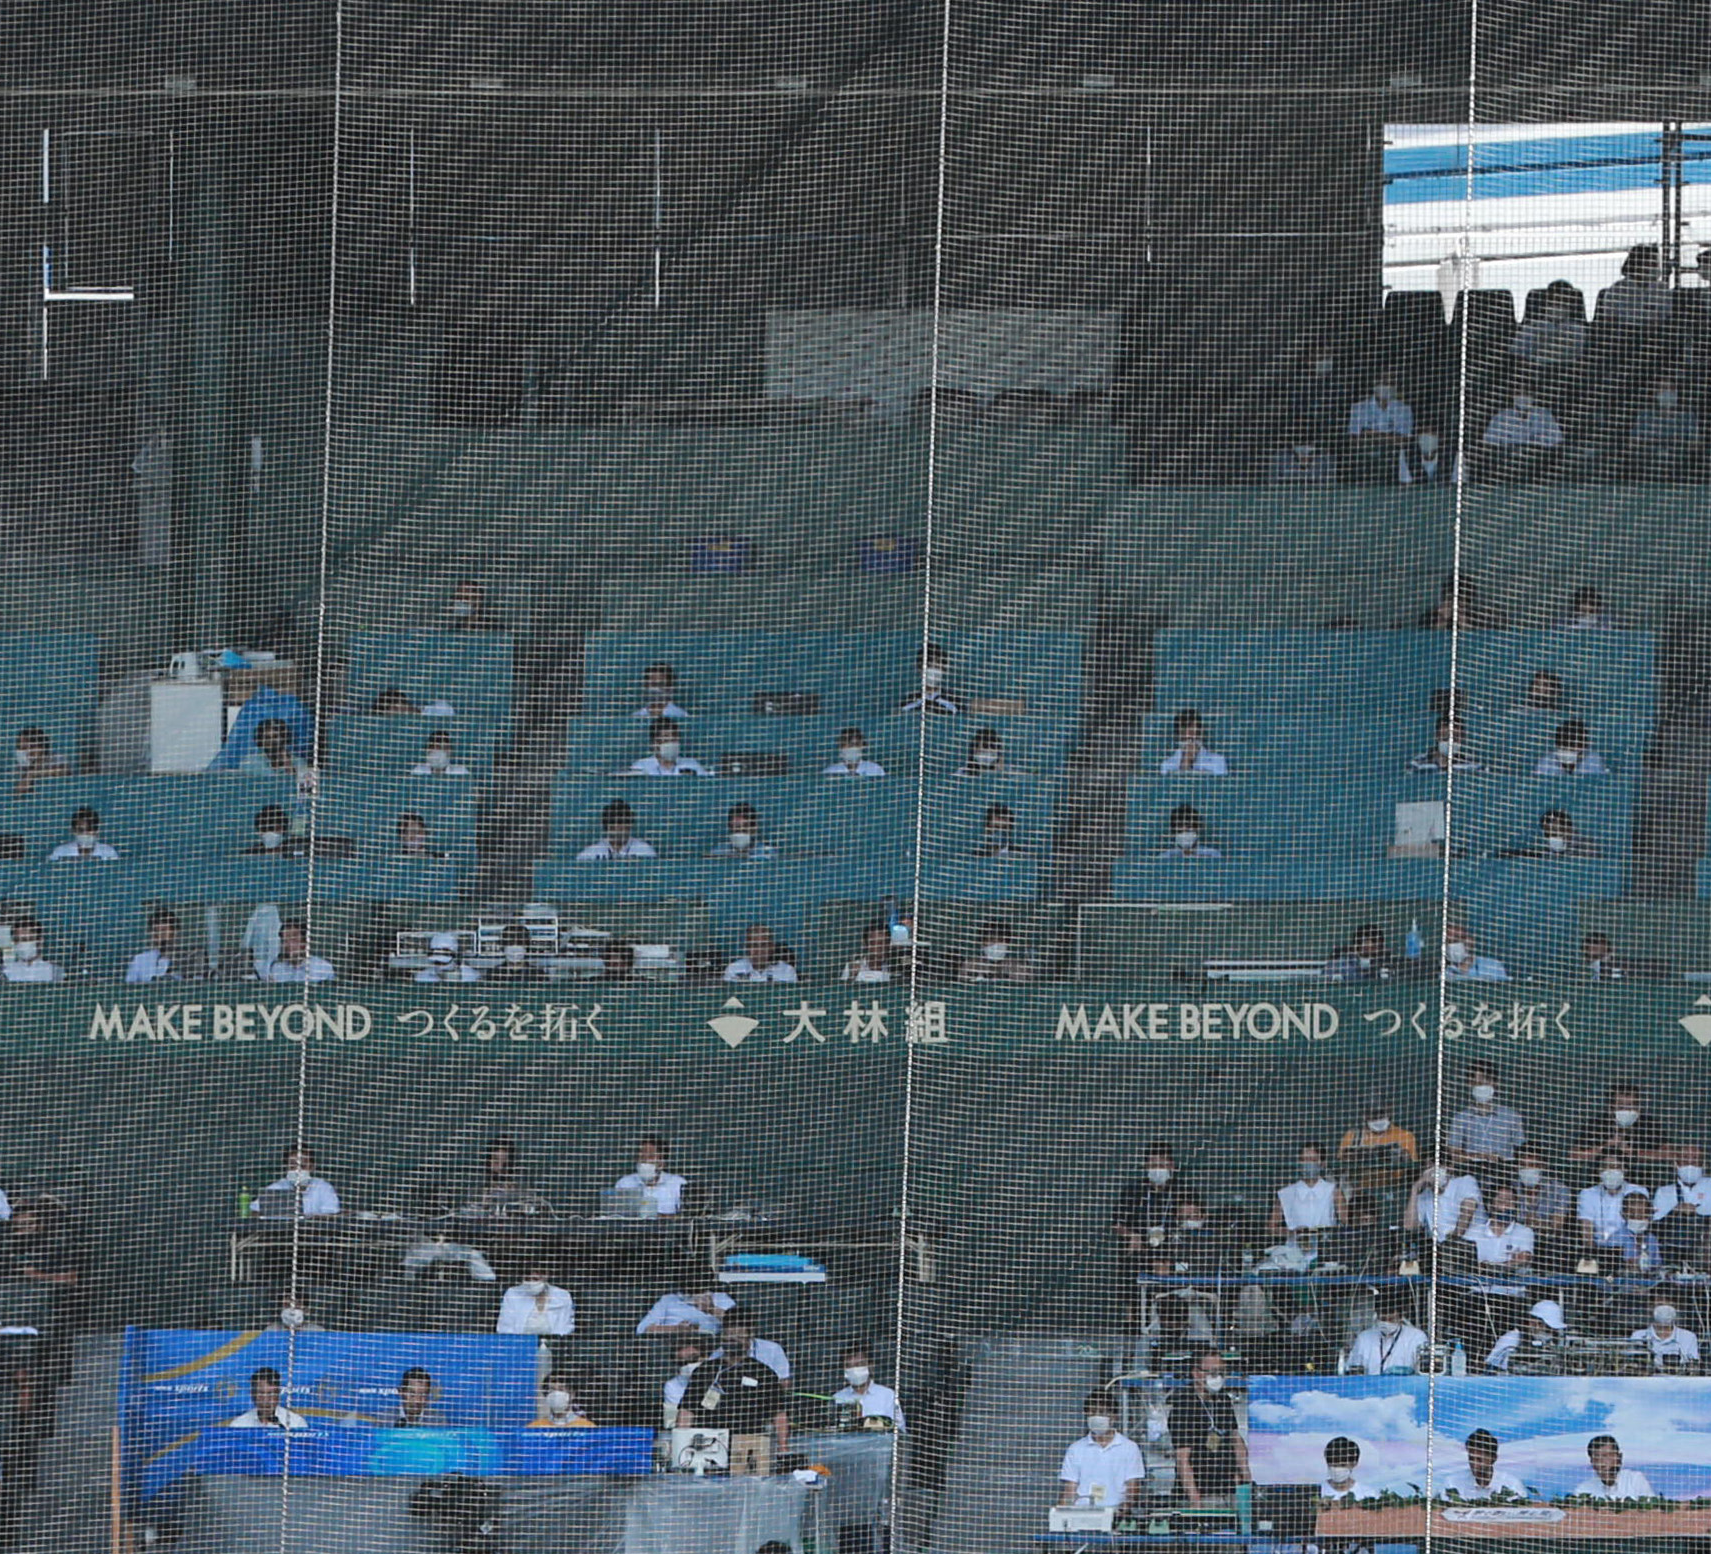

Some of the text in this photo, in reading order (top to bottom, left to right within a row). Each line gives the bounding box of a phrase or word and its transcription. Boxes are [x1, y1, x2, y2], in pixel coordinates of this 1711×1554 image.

[90, 1004, 371, 1041] MAKE BEYOND
[396, 1002, 603, 1043] つくるを拓く
[782, 1001, 946, 1044] 大林組
[1055, 1002, 1338, 1040] MAKE BEYOND
[1362, 1000, 1572, 1042] つくるを拓く
